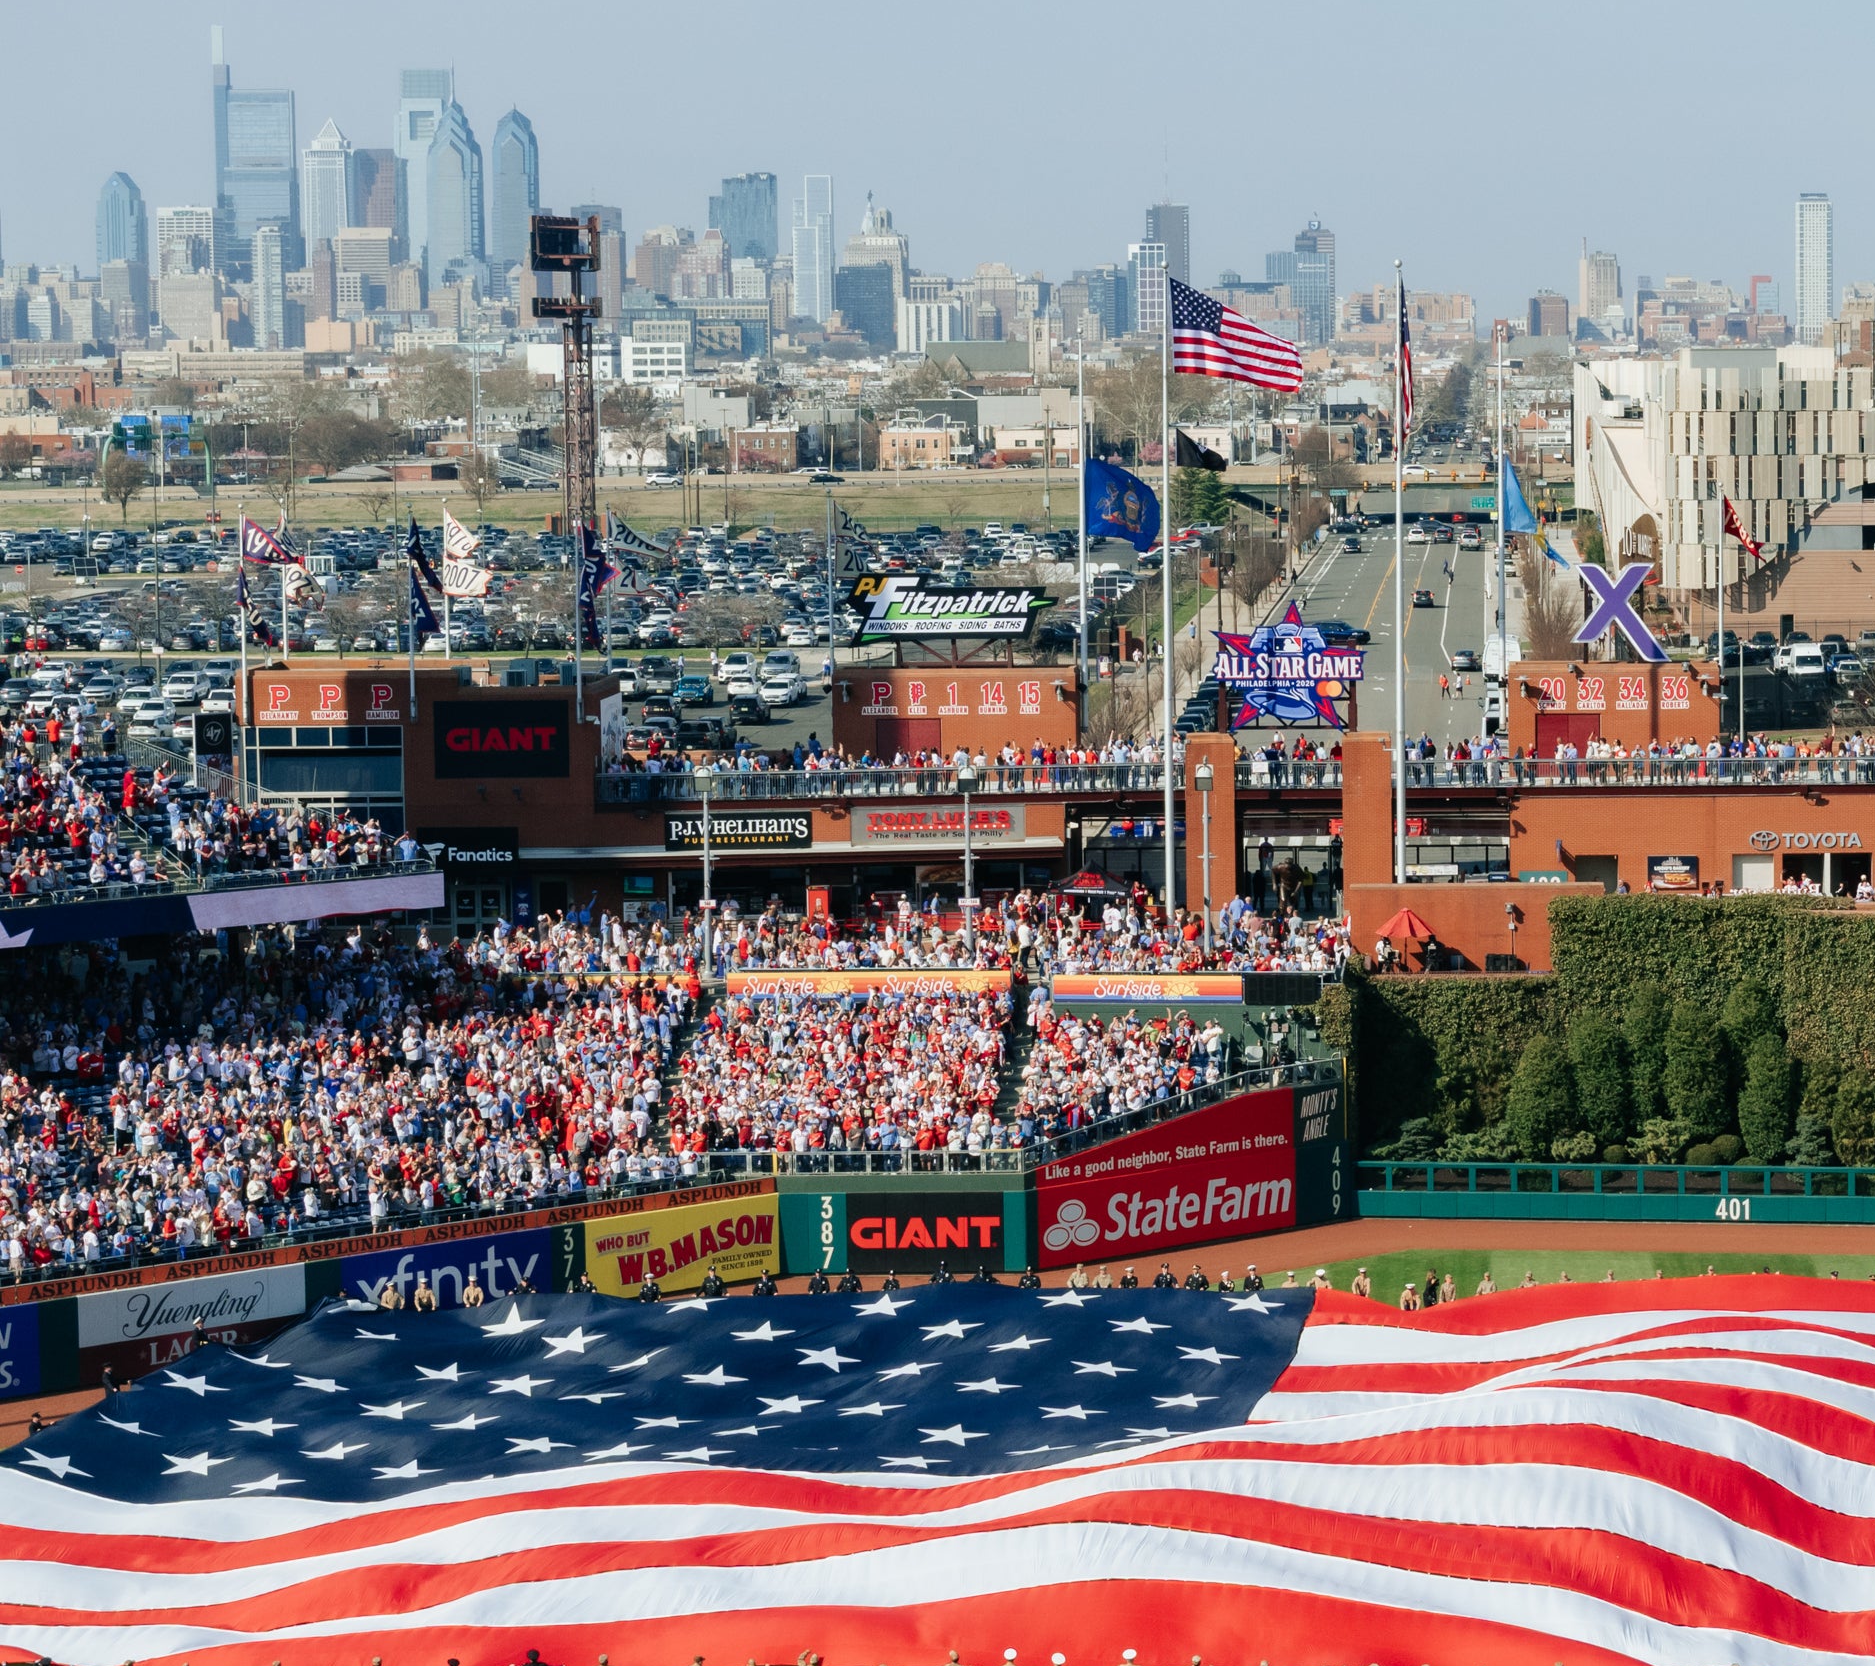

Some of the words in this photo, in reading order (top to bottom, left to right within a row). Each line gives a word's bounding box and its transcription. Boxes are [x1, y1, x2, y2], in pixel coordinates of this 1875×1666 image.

[444, 563, 480, 590] 2007
[854, 577, 888, 596] PJ
[864, 576, 1035, 619] Fitzpatrick
[867, 622, 908, 631] WINDOWS
[915, 621, 952, 631] ROOFING
[958, 621, 987, 630] SIDING
[993, 620, 1022, 630] BATHS
[1308, 653, 1362, 679] GAME
[947, 682, 957, 706] 1
[980, 682, 1005, 706] 14
[1017, 682, 1040, 705] 15
[1235, 680, 1290, 688] PHILADELPHIA
[1295, 679, 1315, 688] 2026
[1539, 677, 1566, 701] 20
[1577, 677, 1604, 701] 32
[1619, 677, 1645, 701] 34
[1662, 676, 1689, 701] 36
[268, 684, 291, 711] P
[320, 684, 342, 711] P
[371, 684, 393, 711] P
[1538, 700, 1566, 710] SCHMIDT
[1577, 700, 1606, 710] CARLTON
[1616, 700, 1648, 710] HALLADAY
[1660, 700, 1689, 709] ROBERTS
[260, 711, 299, 721] DELAHANTY
[311, 710, 348, 720] THOMPSON
[366, 710, 400, 720] HAMILTON
[862, 706, 898, 715] ALEXANDER
[908, 706, 927, 715] KLEIN
[939, 706, 968, 715] ASHBURN
[979, 706, 1007, 715] BUNNING
[1020, 706, 1040, 715] ALLEN
[445, 726, 557, 753] GIANT
[867, 813, 927, 827] TONY
[716, 834, 790, 845] RESTAURANT
[874, 832, 890, 841] The
[894, 832, 911, 841] Real
[914, 831, 937, 840] Taste
[941, 831, 949, 840] of
[979, 830, 1003, 841] Philly
[1782, 832, 1863, 849] TOYOTA
[448, 847, 513, 862] Fanatics
[743, 976, 815, 997] Surfside
[882, 975, 954, 996] Surfside
[1094, 977, 1162, 998] Surfside
[1301, 1087, 1338, 1119] MONTY'S
[1303, 1117, 1330, 1142] ANGLE
[1045, 1164, 1070, 1181] Like
[1074, 1165, 1081, 1176] a
[1085, 1156, 1115, 1177] good
[1117, 1148, 1172, 1170] neighbor,
[1175, 1144, 1206, 1161] State
[1209, 1140, 1240, 1155] Farm
[1242, 1136, 1251, 1151] is
[1254, 1133, 1288, 1149] there.
[1332, 1146, 1341, 1215] 409
[667, 1182, 762, 1207] ASPLUNDH
[547, 1197, 645, 1224] ASPLUNDH
[1715, 1198, 1751, 1221] 401
[424, 1215, 526, 1242] ASPLUNDH
[820, 1195, 835, 1270] 387
[850, 1215, 998, 1250] GIANT
[297, 1235, 404, 1261] ASPLUNDH
[595, 1235, 623, 1254] WHO
[627, 1231, 650, 1248] BUT
[670, 1215, 775, 1270] MASON
[166, 1252, 276, 1280] ASPLUNDH
[712, 1253, 741, 1265] FAMILY
[743, 1249, 773, 1261] OWNED
[721, 1260, 744, 1271] SINCE
[746, 1258, 764, 1268] 1898
[28, 1271, 143, 1301] ASPLUNDH
[122, 1281, 264, 1338] Yuengling
